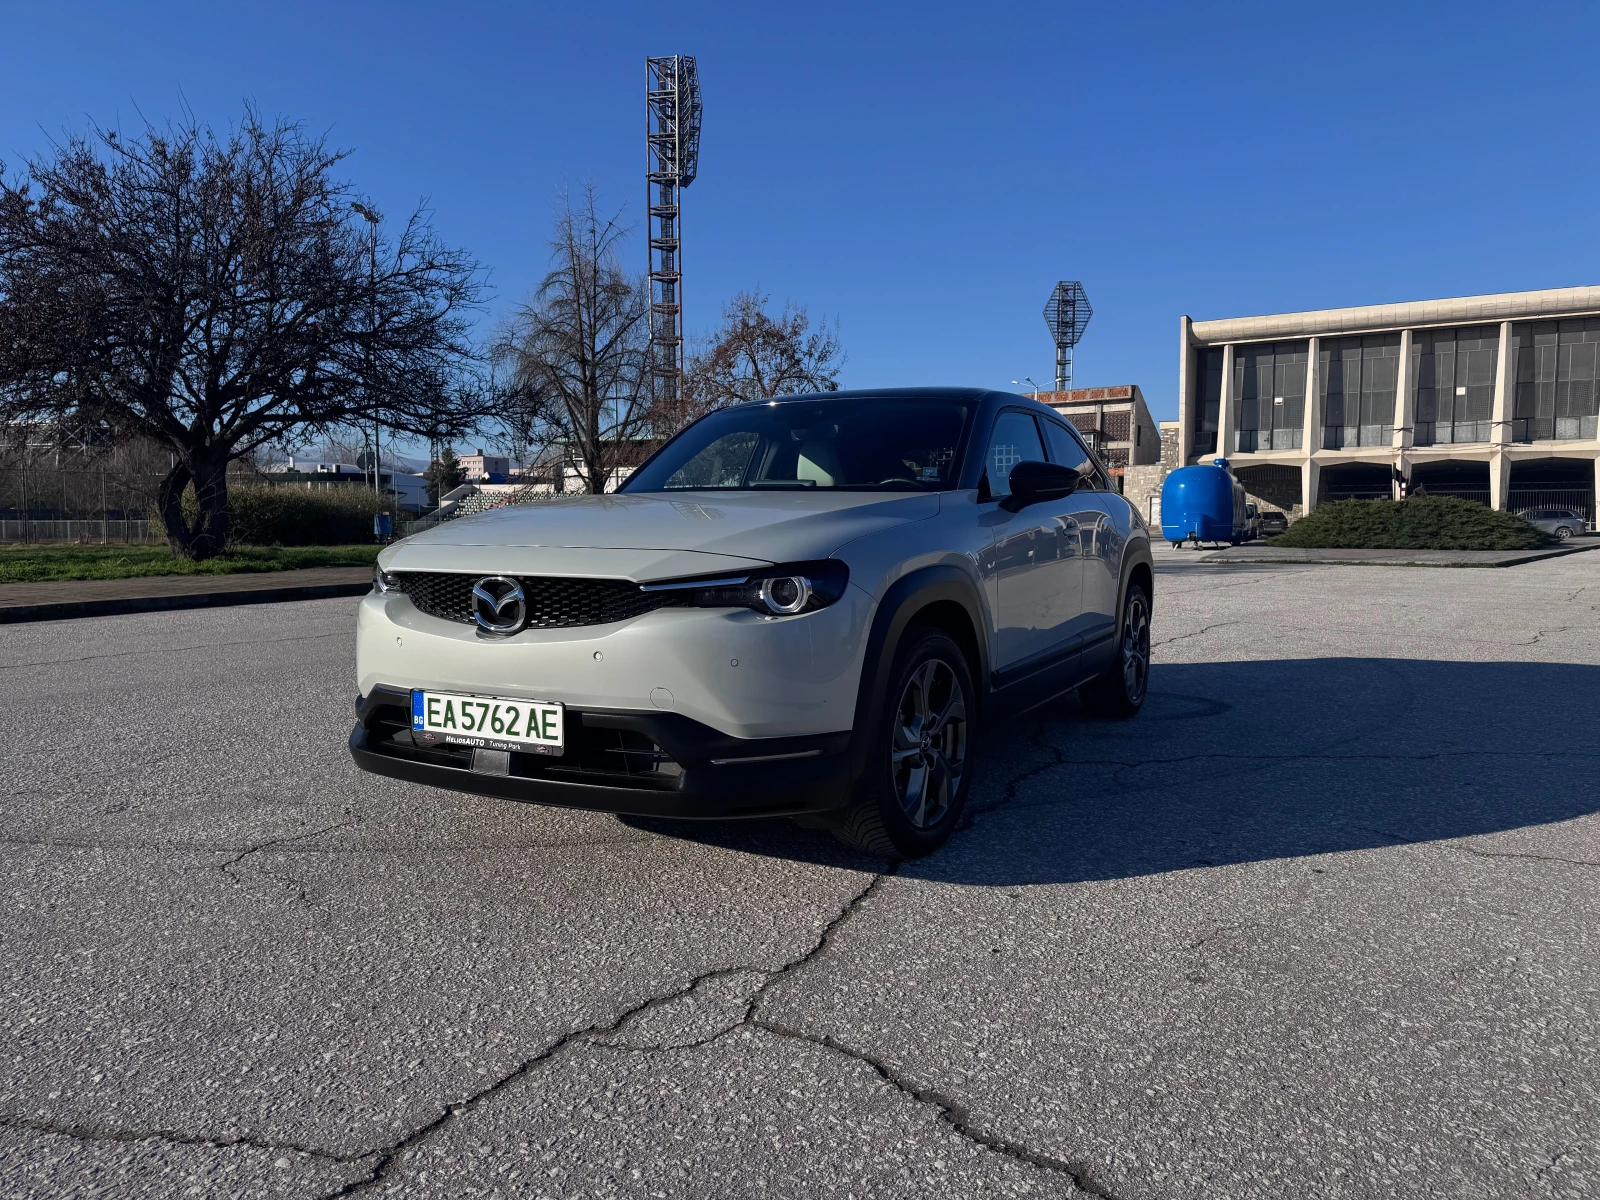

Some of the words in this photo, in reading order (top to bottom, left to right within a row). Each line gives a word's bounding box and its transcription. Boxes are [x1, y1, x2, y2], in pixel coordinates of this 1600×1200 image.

[413, 716, 423, 724] BG
[461, 701, 520, 736] 5762
[489, 740, 508, 750] Tuning
[508, 742, 521, 750] Park
